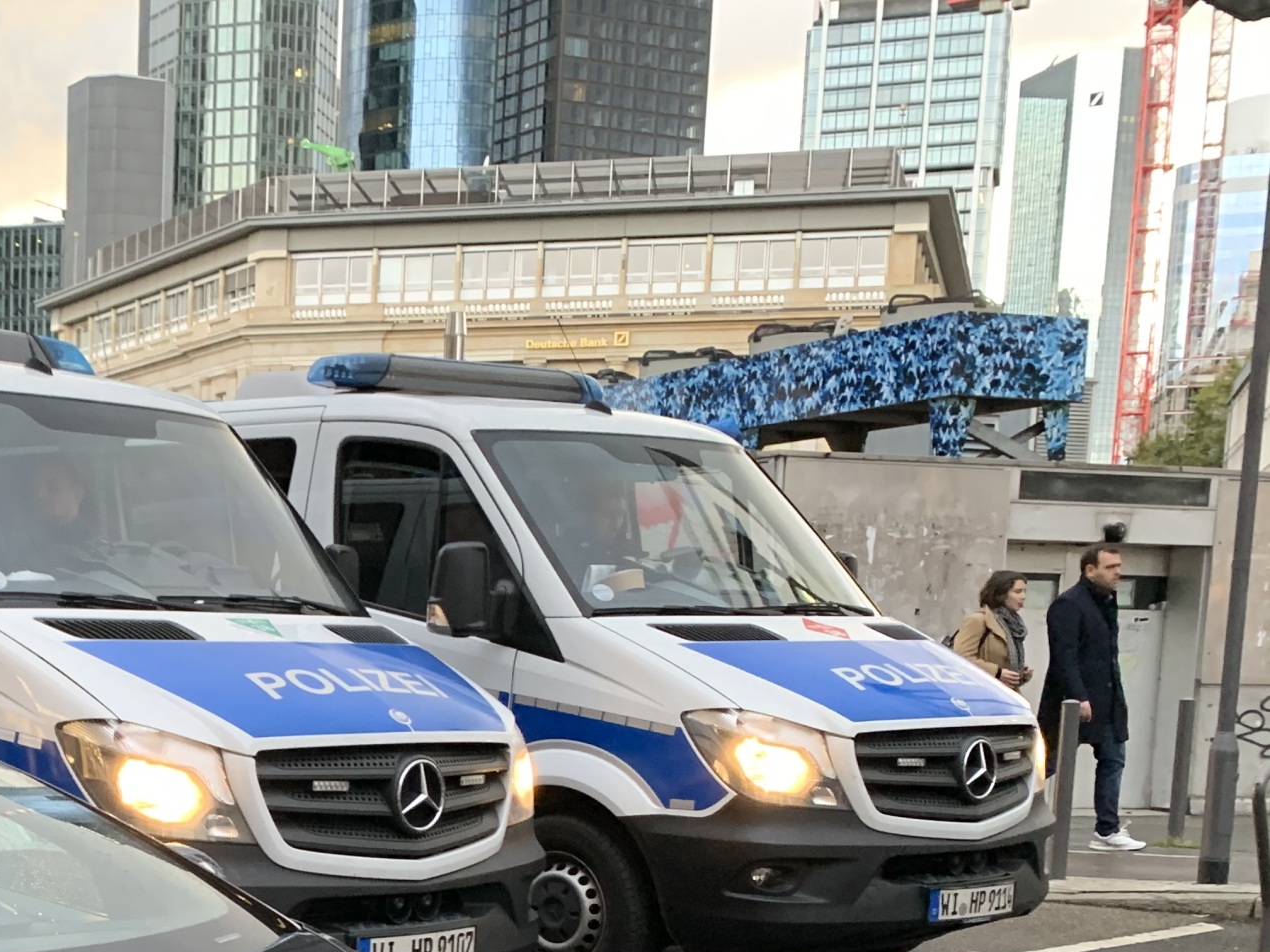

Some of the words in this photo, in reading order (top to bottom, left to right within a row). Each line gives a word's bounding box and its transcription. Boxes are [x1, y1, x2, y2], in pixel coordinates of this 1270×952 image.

[525, 338, 577, 349] Deutsche
[579, 336, 608, 348] Bank
[244, 667, 449, 700] POLIZEI
[969, 890, 987, 914] HP
